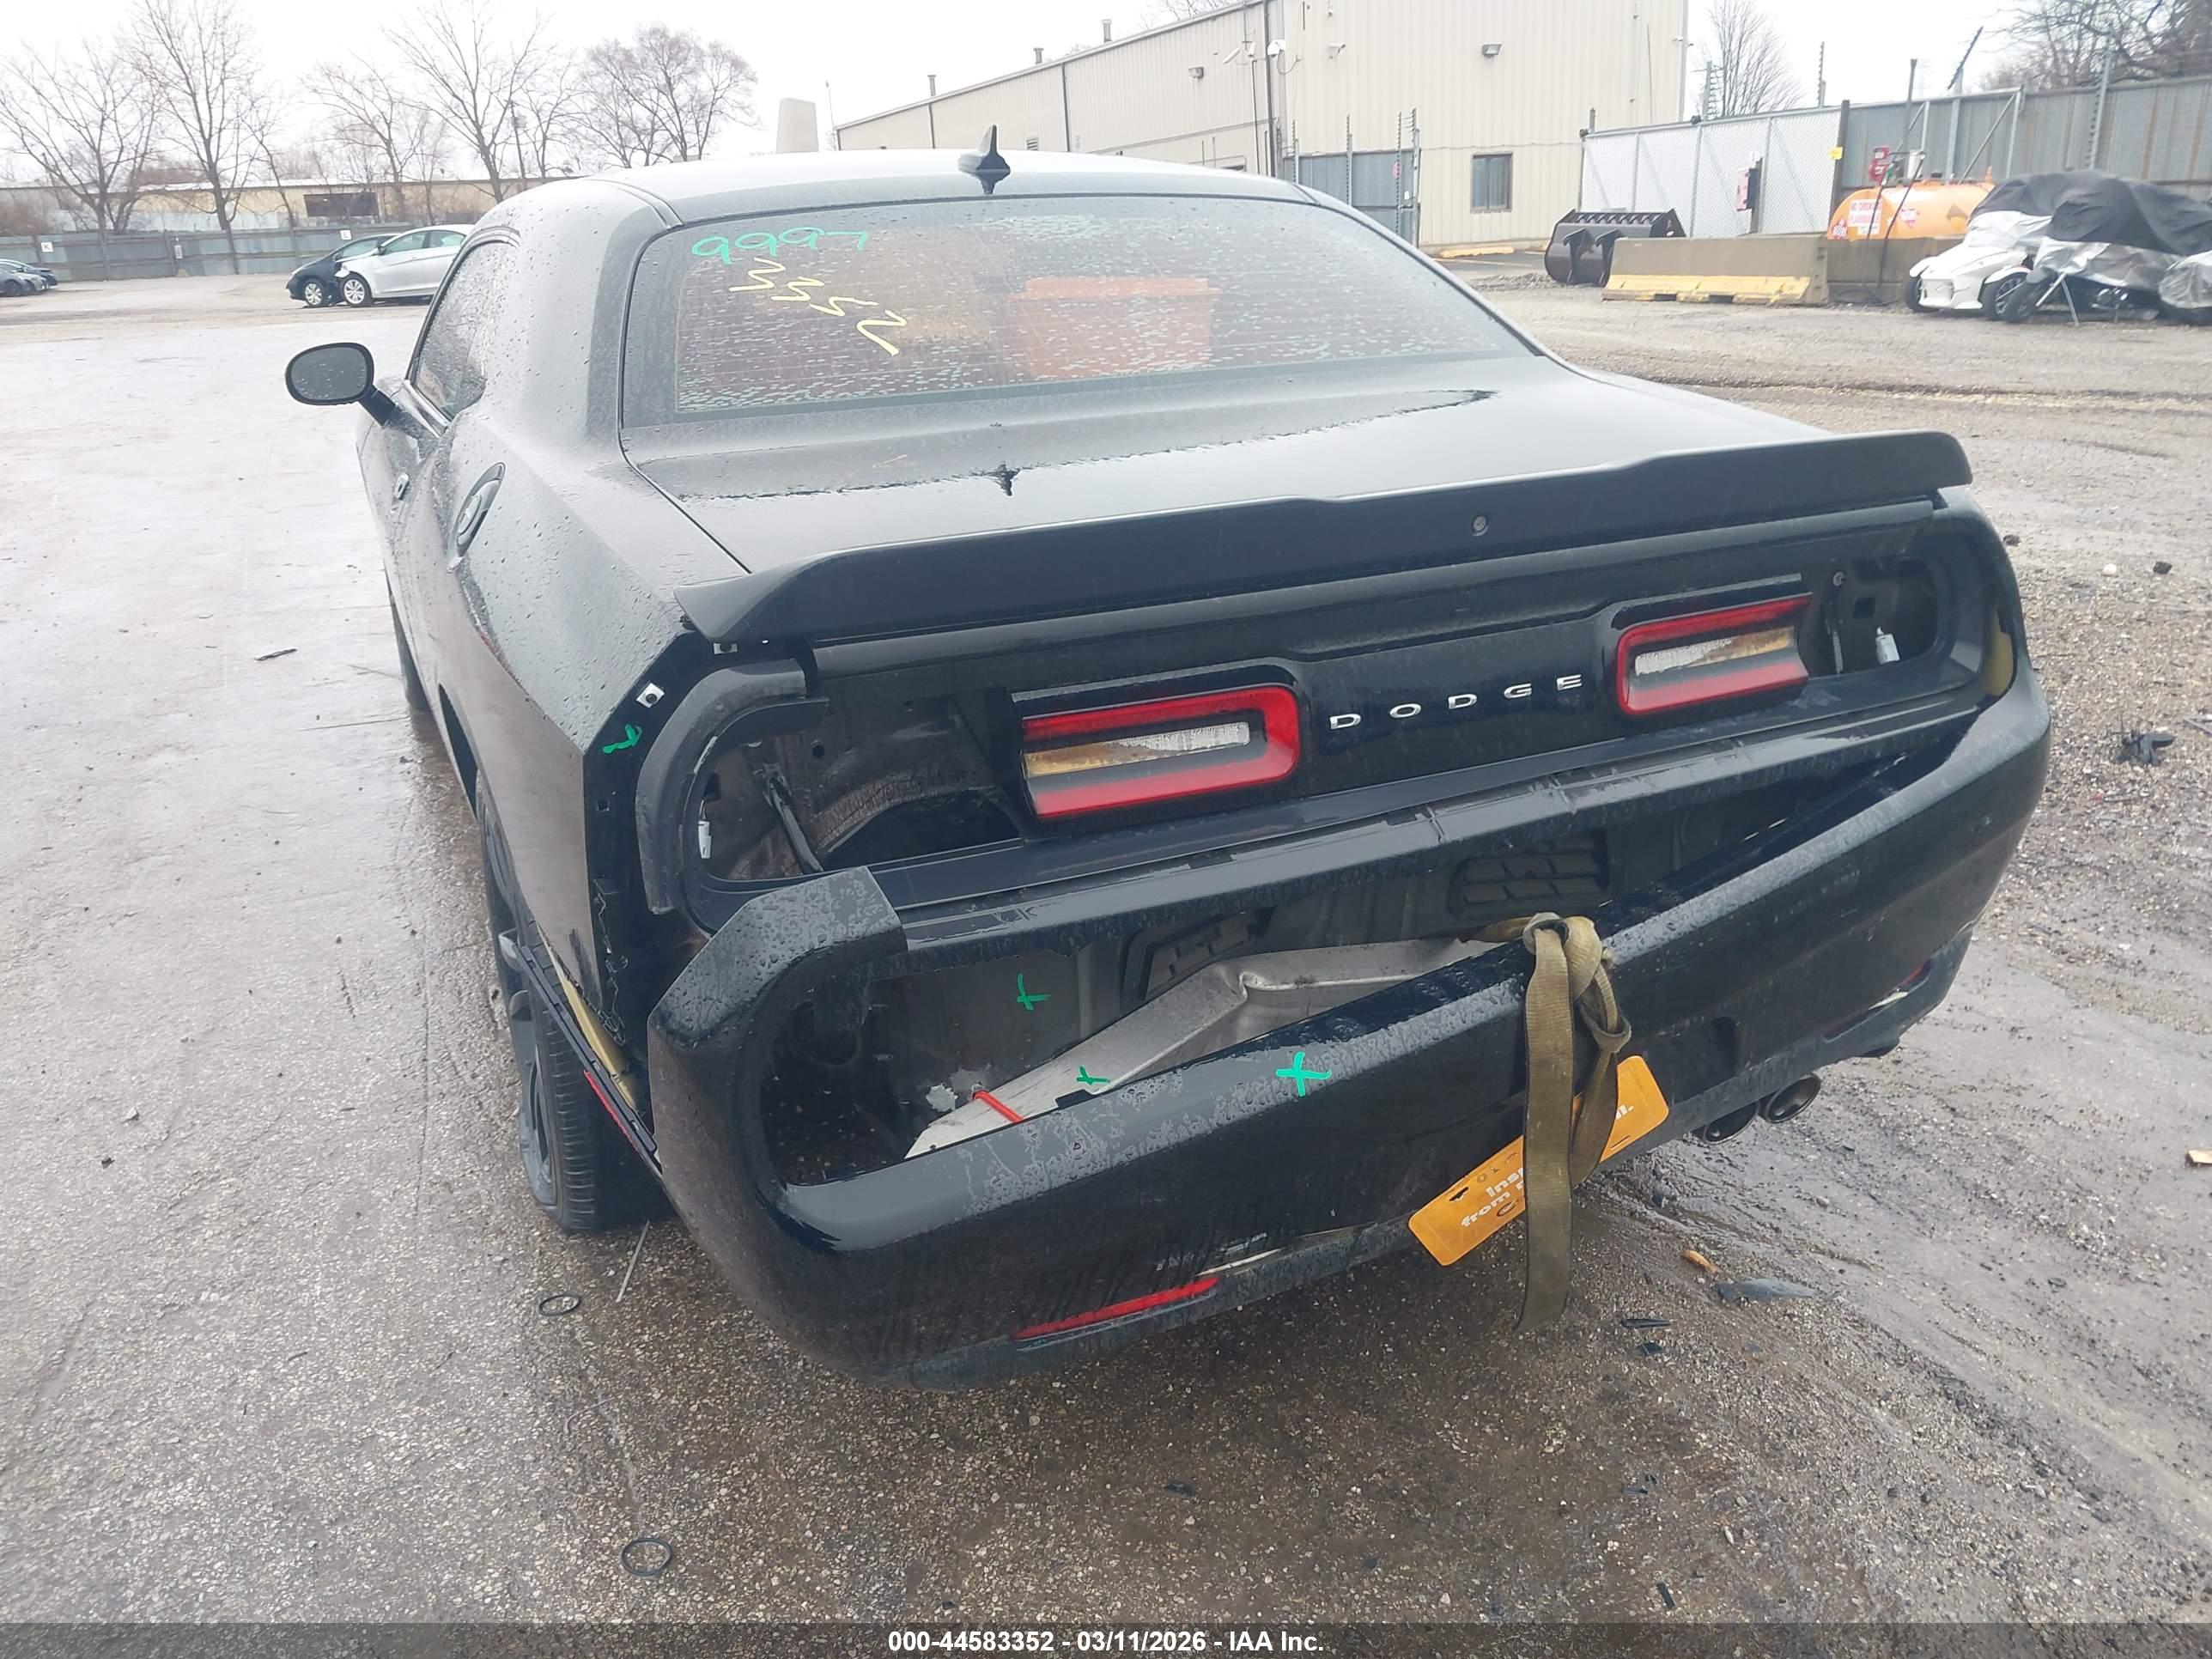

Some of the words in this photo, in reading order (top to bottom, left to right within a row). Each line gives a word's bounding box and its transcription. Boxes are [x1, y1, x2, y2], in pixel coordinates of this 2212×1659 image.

[691, 226, 867, 264] 9997
[1329, 674, 1583, 730] DODGE
[1461, 1190, 1511, 1227] from
